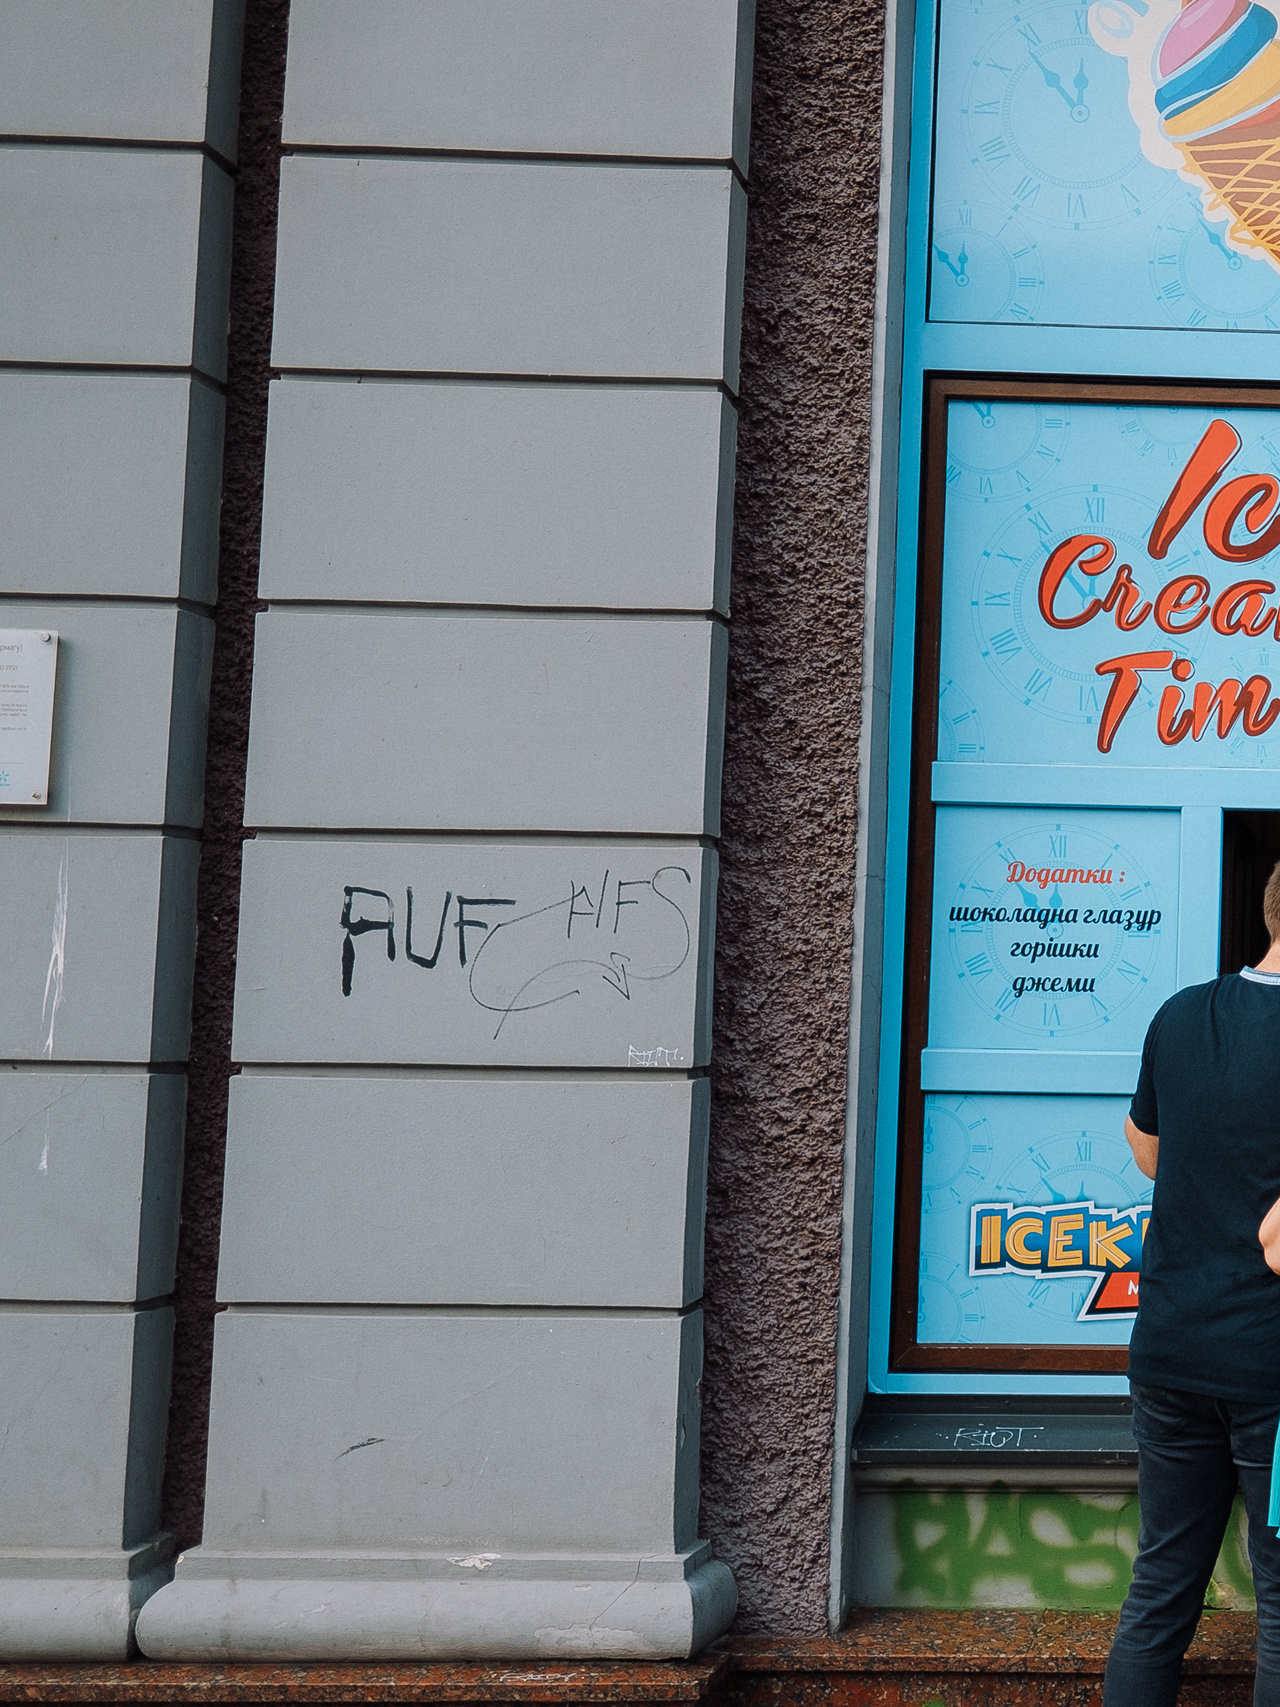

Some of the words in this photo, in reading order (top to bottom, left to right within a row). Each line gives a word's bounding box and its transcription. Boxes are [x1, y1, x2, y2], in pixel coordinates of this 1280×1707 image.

[1006, 861, 1113, 889] Додатки
[949, 906, 1078, 929] шоколадна
[1083, 908, 1162, 931] глазур
[1010, 937, 1100, 963] горішки
[1012, 976, 1096, 998] джеми
[980, 1213, 1151, 1269] ICEK
